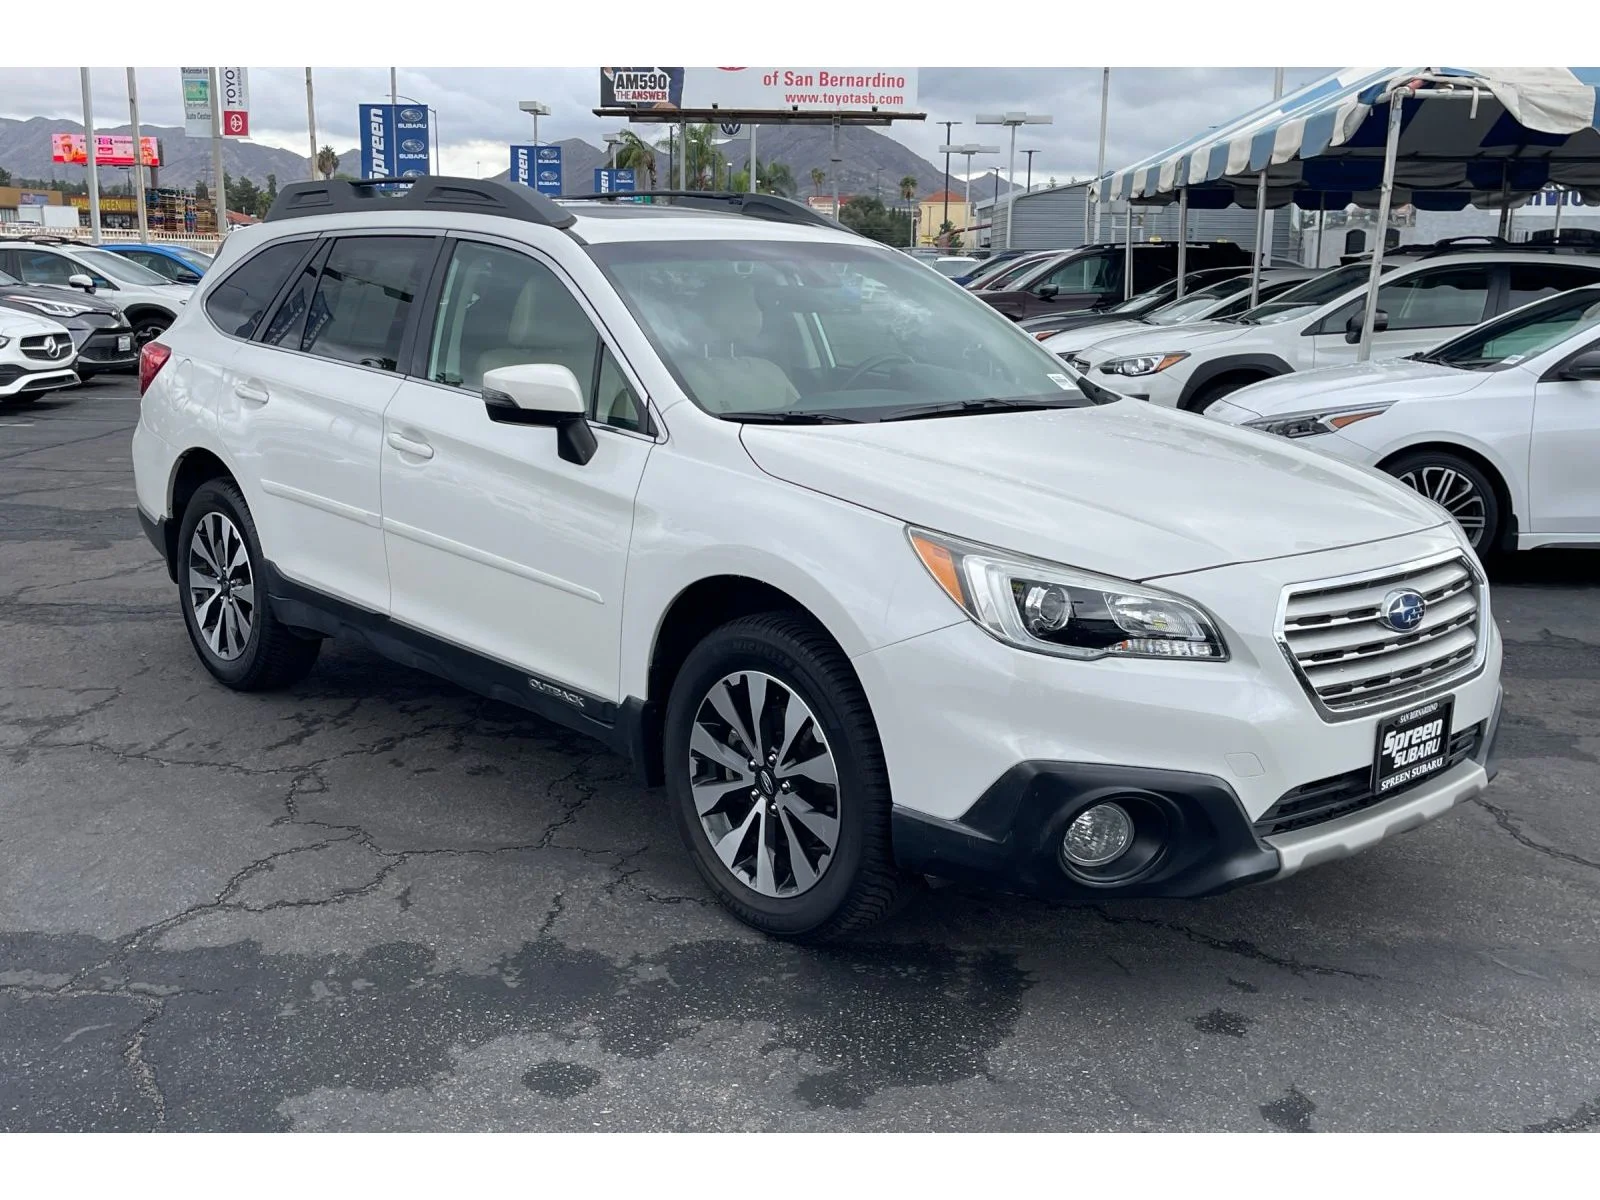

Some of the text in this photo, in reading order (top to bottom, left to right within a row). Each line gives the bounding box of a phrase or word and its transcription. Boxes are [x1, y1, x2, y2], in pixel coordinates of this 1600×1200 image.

[224, 67, 236, 106] TOYO
[616, 74, 667, 90] AM590
[763, 71, 905, 88] of San Bernardino
[616, 91, 667, 101] THE ANSWER
[785, 92, 904, 106] www.toyotasb.com
[1400, 712, 1410, 723] SAN
[1382, 719, 1443, 758] Spreen
[1393, 737, 1441, 769] SUBARU
[1381, 757, 1443, 791] SPREEN SUBARU
